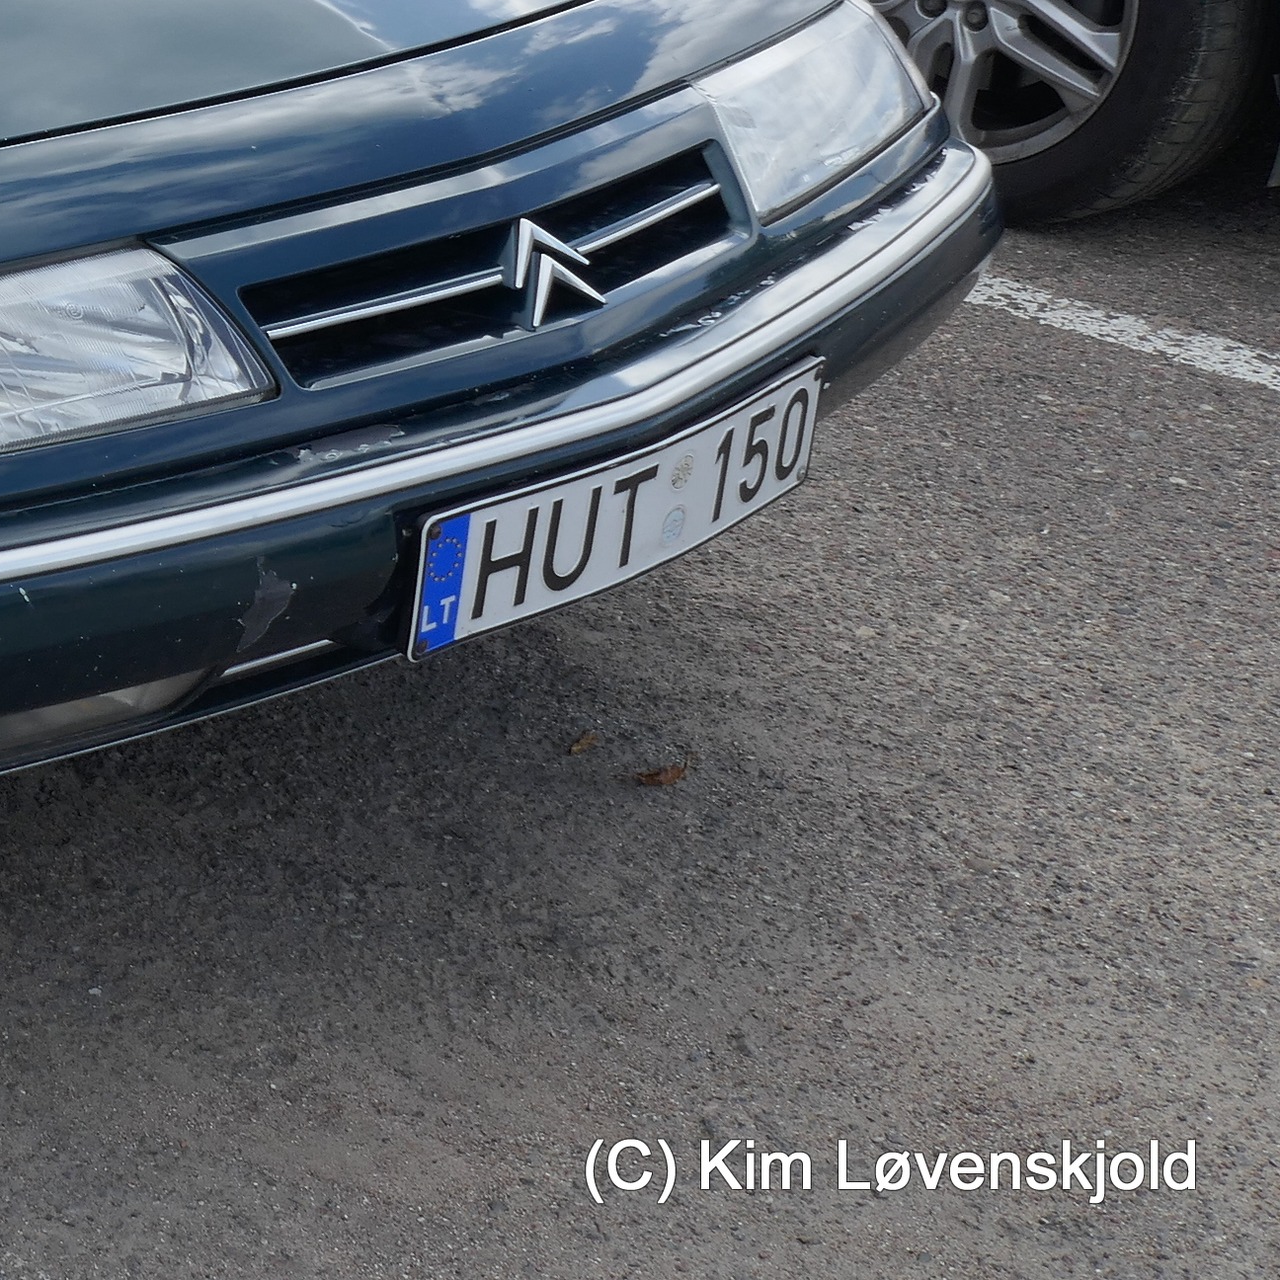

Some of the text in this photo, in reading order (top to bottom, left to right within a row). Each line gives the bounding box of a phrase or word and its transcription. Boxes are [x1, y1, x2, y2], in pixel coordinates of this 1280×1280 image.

[472, 387, 810, 619] HUT 150
[421, 595, 456, 632] LT
